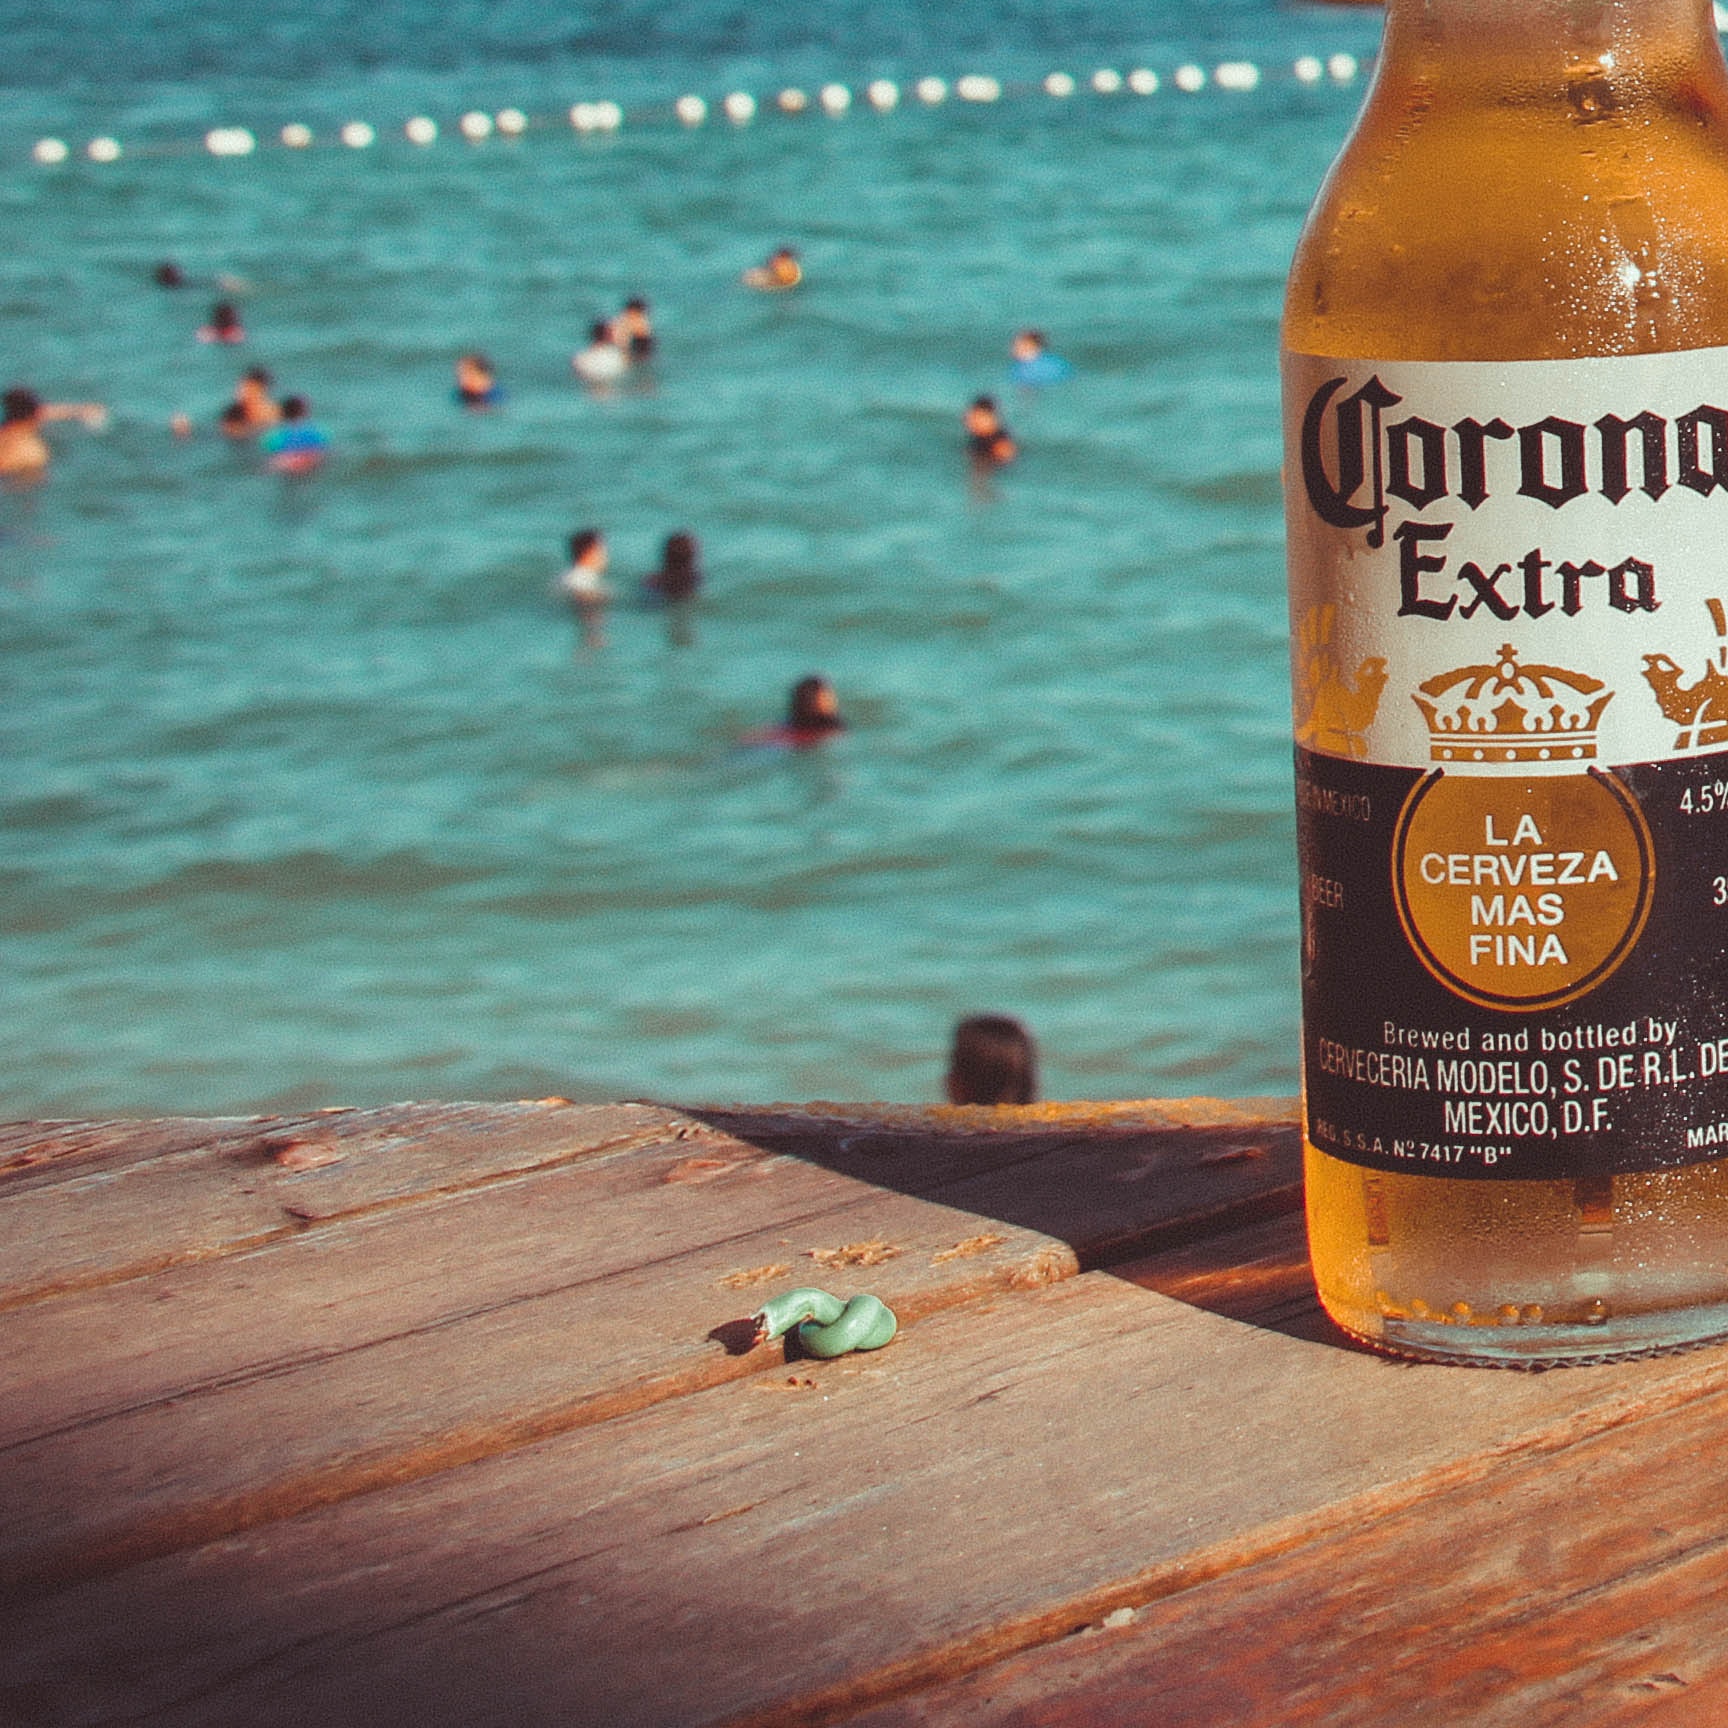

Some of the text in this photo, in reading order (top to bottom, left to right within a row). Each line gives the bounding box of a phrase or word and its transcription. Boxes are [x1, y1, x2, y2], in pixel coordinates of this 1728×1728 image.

[1393, 520, 1661, 621] Extra
[1485, 814, 1543, 846] LA
[1420, 852, 1618, 886] CERVEZA
[1471, 894, 1564, 926] MAS
[1469, 935, 1568, 966] FINA
[1384, 1018, 1678, 1052] Brewed and bottled by
[1318, 1037, 1428, 1091] CERVECERIA
[1437, 1058, 1556, 1098] MODELO,
[1563, 1058, 1590, 1094] S.
[1599, 1052, 1635, 1090] DE
[1444, 1098, 1613, 1139] MEXICO, D.F.
